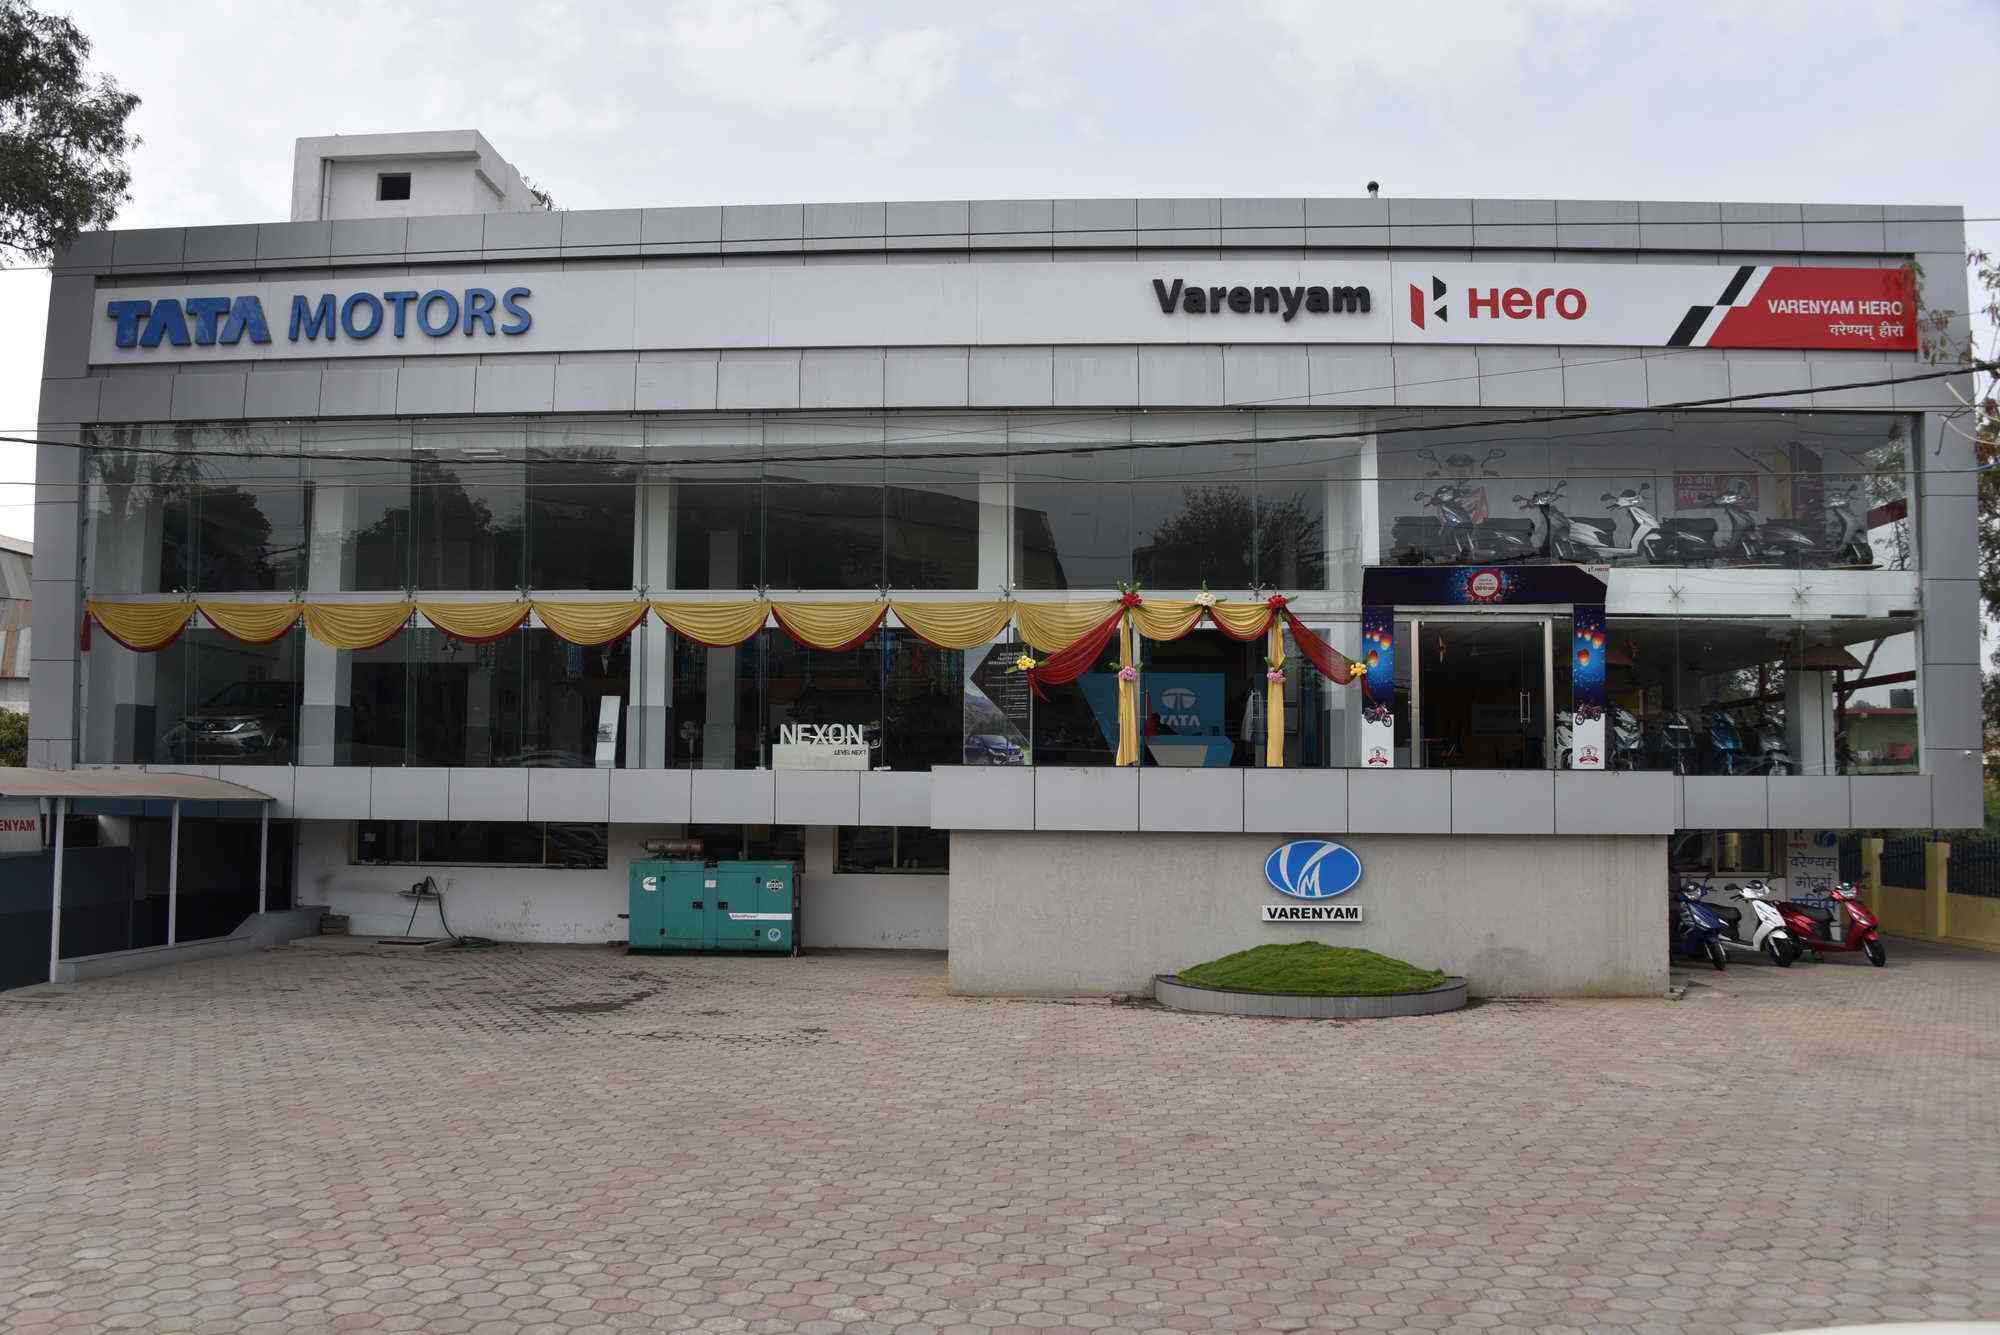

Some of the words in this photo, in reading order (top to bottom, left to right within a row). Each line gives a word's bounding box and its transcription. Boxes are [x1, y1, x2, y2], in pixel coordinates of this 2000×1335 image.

[1152, 278, 1371, 323] Varenyam
[1767, 299, 1854, 315] VARENYAM
[1858, 300, 1903, 316] HERO
[107, 296, 271, 348] TATA
[288, 287, 532, 342] MOTORS
[780, 724, 864, 745] NEXON
[1267, 907, 1358, 919] VARENYAM
